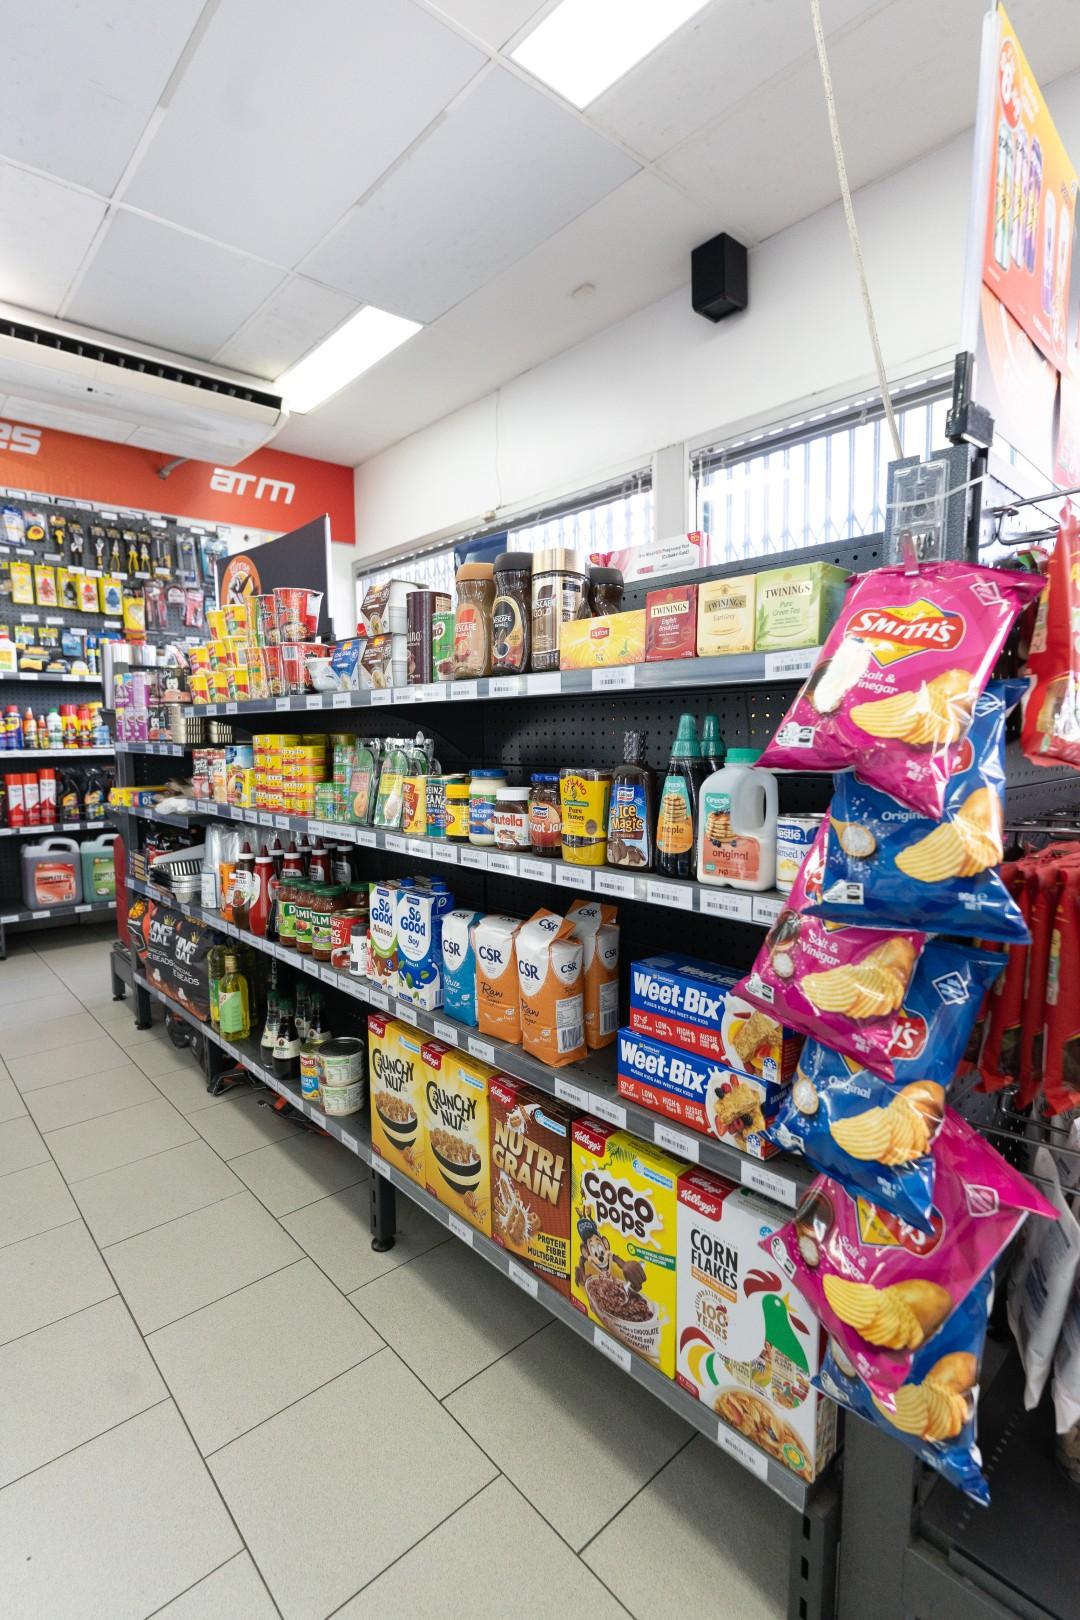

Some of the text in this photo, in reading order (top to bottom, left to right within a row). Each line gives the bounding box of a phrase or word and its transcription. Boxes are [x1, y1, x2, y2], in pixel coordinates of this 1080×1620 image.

[765, 583, 810, 599] TWININGS
[652, 602, 688, 616] TWININGS
[708, 596, 745, 611] TWININGS
[661, 617, 677, 625] English
[850, 612, 957, 642] SMITH'S
[858, 679, 898, 694] inegar
[885, 673, 896, 684] &
[618, 804, 637, 817] Ice
[490, 813, 523, 828] nutella
[611, 817, 644, 832] Magic
[712, 848, 749, 861] original
[372, 908, 393, 927] Good
[578, 907, 598, 918] CSR
[400, 917, 426, 937] Good
[538, 918, 559, 932] CSR
[408, 935, 420, 949] Soy
[443, 939, 461, 957] CSR
[809, 928, 839, 954] Salt &
[479, 945, 503, 964] CSR
[604, 949, 617, 959] CSR
[802, 941, 840, 966] Vinegar
[518, 960, 540, 981] CSR
[561, 961, 577, 974] CSR
[480, 981, 503, 998] Raw
[633, 971, 720, 1021] Weet-Bix
[520, 998, 540, 1017] Raw
[655, 1020, 667, 1031] LOW
[372, 1048, 415, 1084] CRUNCHY
[621, 1038, 706, 1094] Weet-Bix
[384, 1073, 405, 1093] NUT
[426, 1081, 477, 1121] CRUNCHY
[490, 1085, 513, 1104] Kellogg's
[641, 1088, 653, 1099] LOW
[440, 1109, 466, 1131] NUT
[494, 1116, 565, 1182] NUTRI
[573, 1130, 603, 1152] Kellogg's
[492, 1143, 561, 1207] GRAIN
[680, 1188, 718, 1215] Kellogg's
[537, 1233, 566, 1250] PROTEIN
[690, 1228, 739, 1274] CORN
[527, 1246, 566, 1268] MULTIGRAIN
[546, 1245, 566, 1259] FIBRE
[691, 1248, 738, 1291] FLAKES
[701, 1300, 727, 1328] 100
[696, 1310, 728, 1341] YEARS
